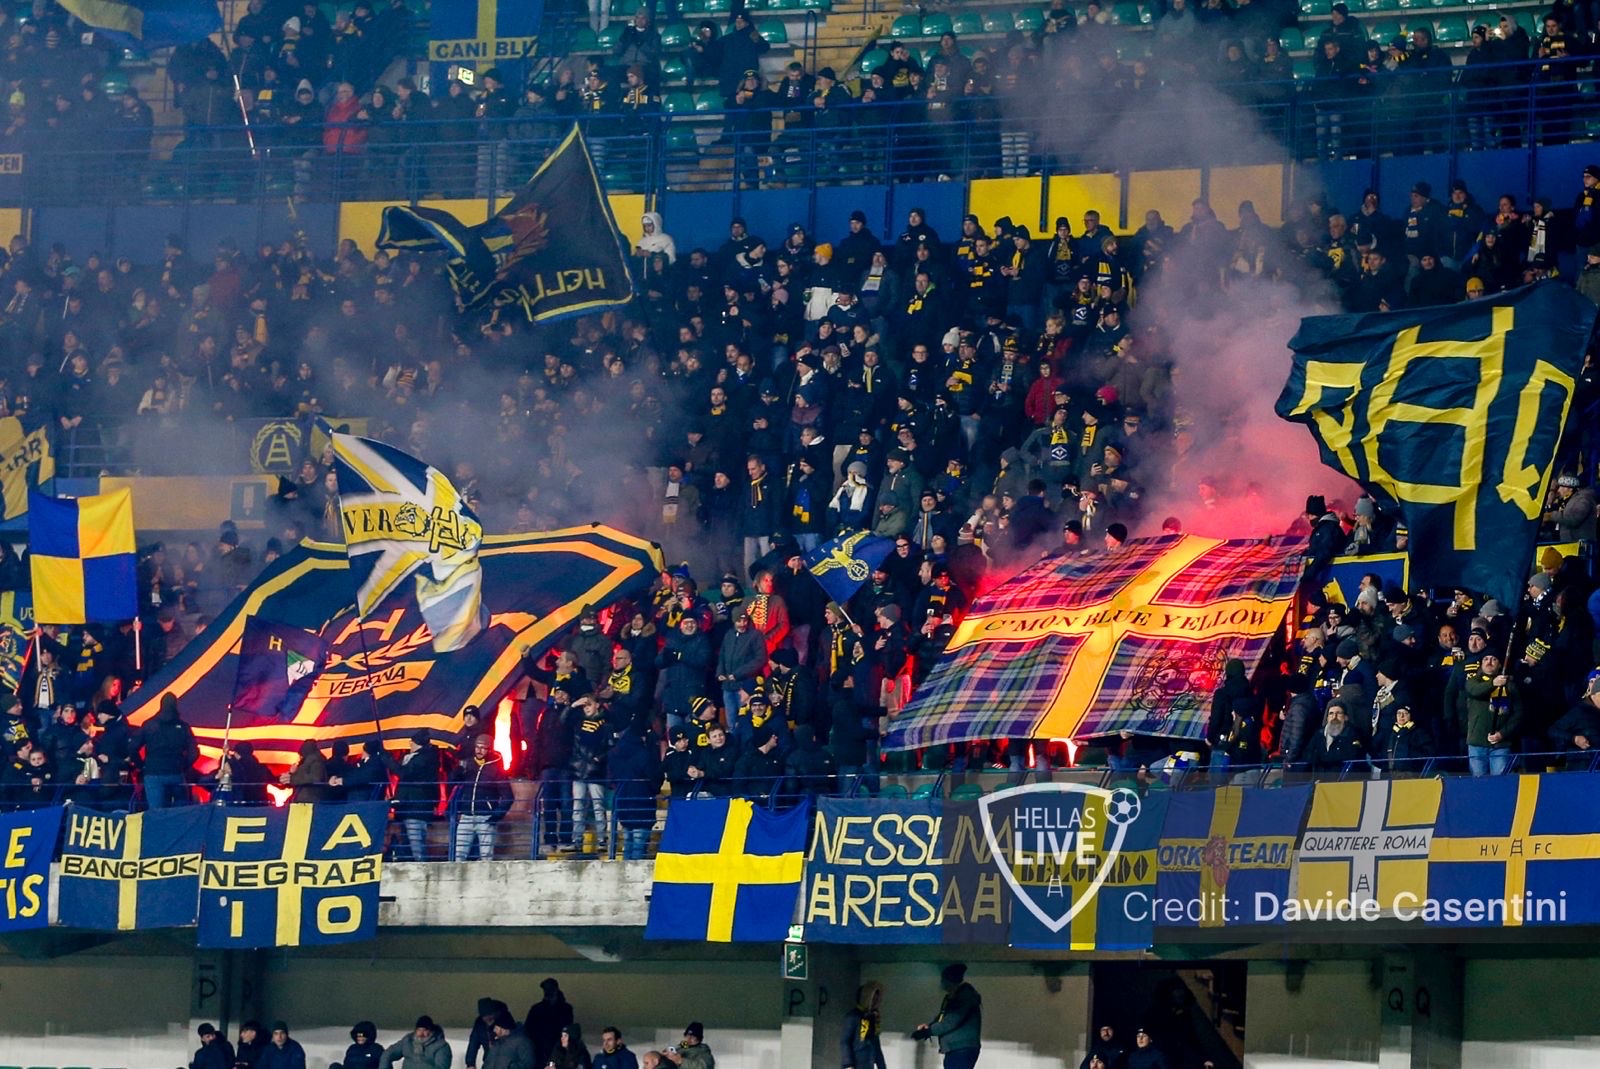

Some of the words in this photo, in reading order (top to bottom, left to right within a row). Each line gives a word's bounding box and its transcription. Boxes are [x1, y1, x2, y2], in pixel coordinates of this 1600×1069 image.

[435, 42, 487, 58] CANI
[343, 508, 393, 535] VER
[984, 614, 1079, 633] C'MON
[1085, 609, 1152, 627] BLUE
[1160, 610, 1272, 631] YELLOW
[329, 665, 406, 696] VERONA
[5, 827, 32, 869] E
[1158, 845, 1202, 867] ORK
[1228, 843, 1289, 864] TEAM
[1304, 836, 1379, 852] QUARTIERE
[1383, 835, 1428, 850] ROMA
[64, 855, 199, 879] BANGKOK
[203, 857, 376, 887] NEGRAR
